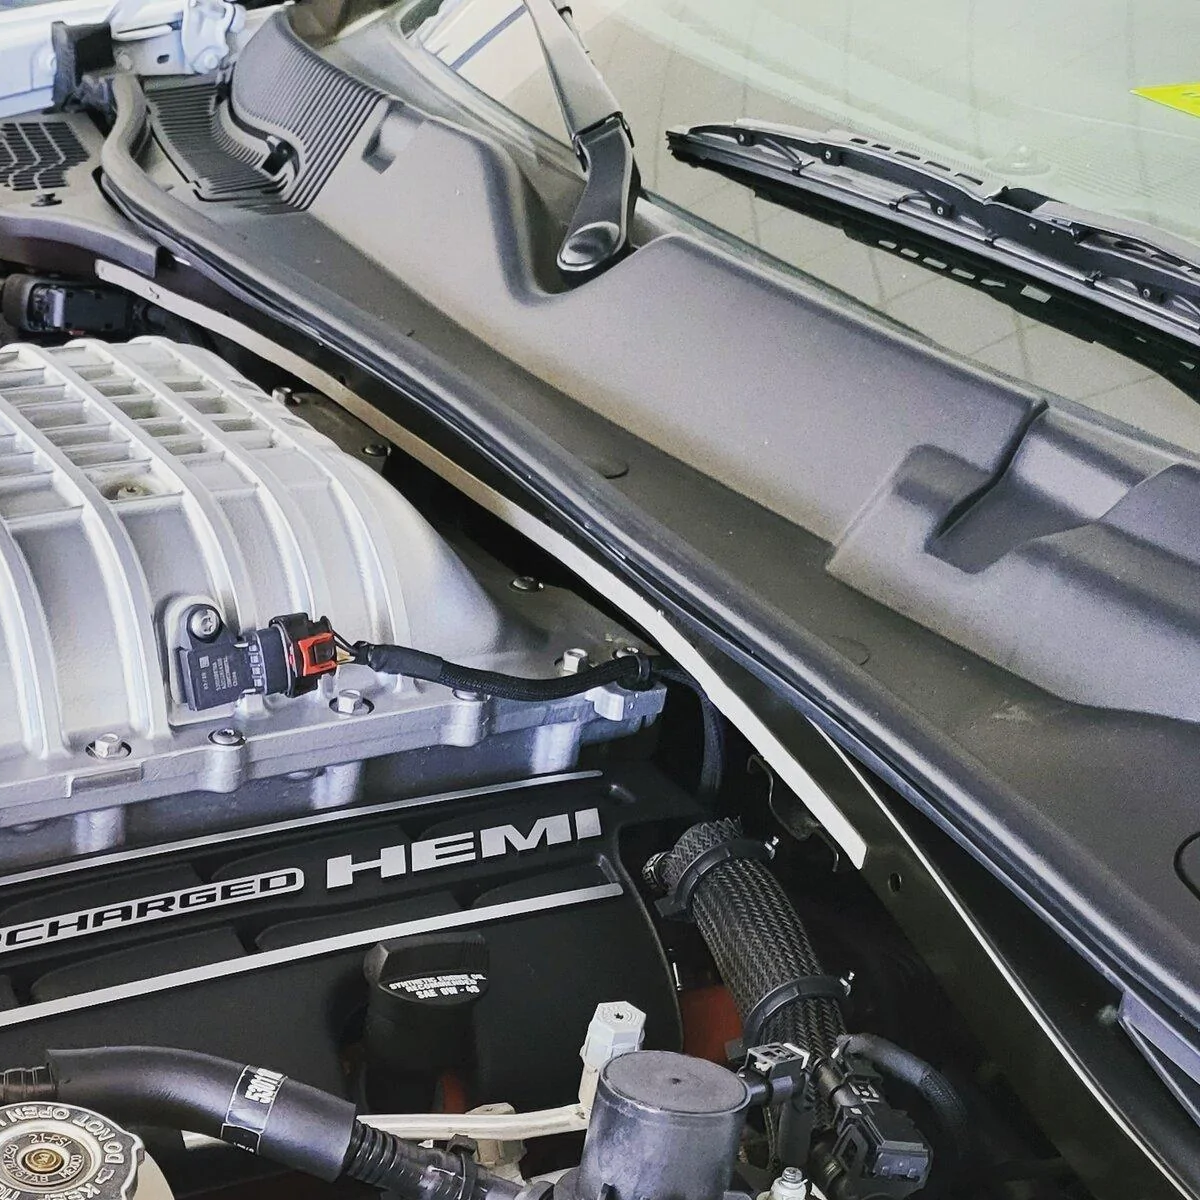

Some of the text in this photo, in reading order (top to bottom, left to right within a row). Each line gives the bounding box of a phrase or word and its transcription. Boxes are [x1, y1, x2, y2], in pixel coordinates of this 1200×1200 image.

[326, 808, 601, 889] HEMI
[389, 977, 438, 990] SYNTHETIC
[416, 988, 438, 999] SAE
[6, 1105, 70, 1122] OPEN
[72, 1115, 116, 1142] NOT
[103, 1141, 125, 1164] DO
